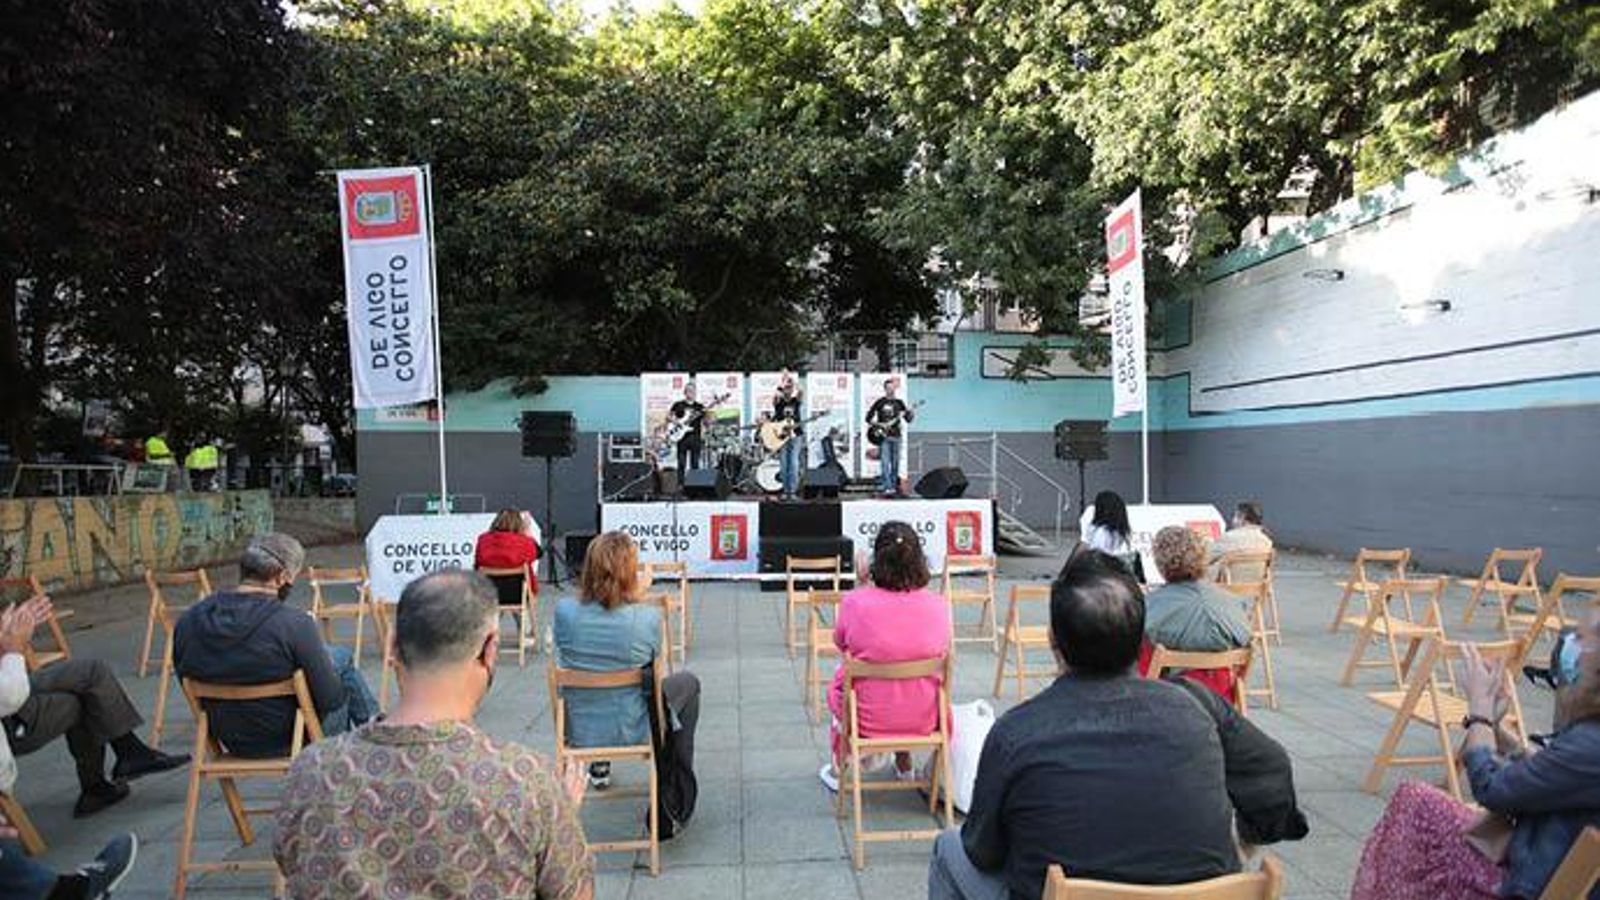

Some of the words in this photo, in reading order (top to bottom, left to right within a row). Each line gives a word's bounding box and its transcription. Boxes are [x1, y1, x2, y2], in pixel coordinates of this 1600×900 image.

[383, 542, 473, 558] CONCELLO
[653, 540, 690, 551] VIGO
[393, 560, 415, 574] DE
